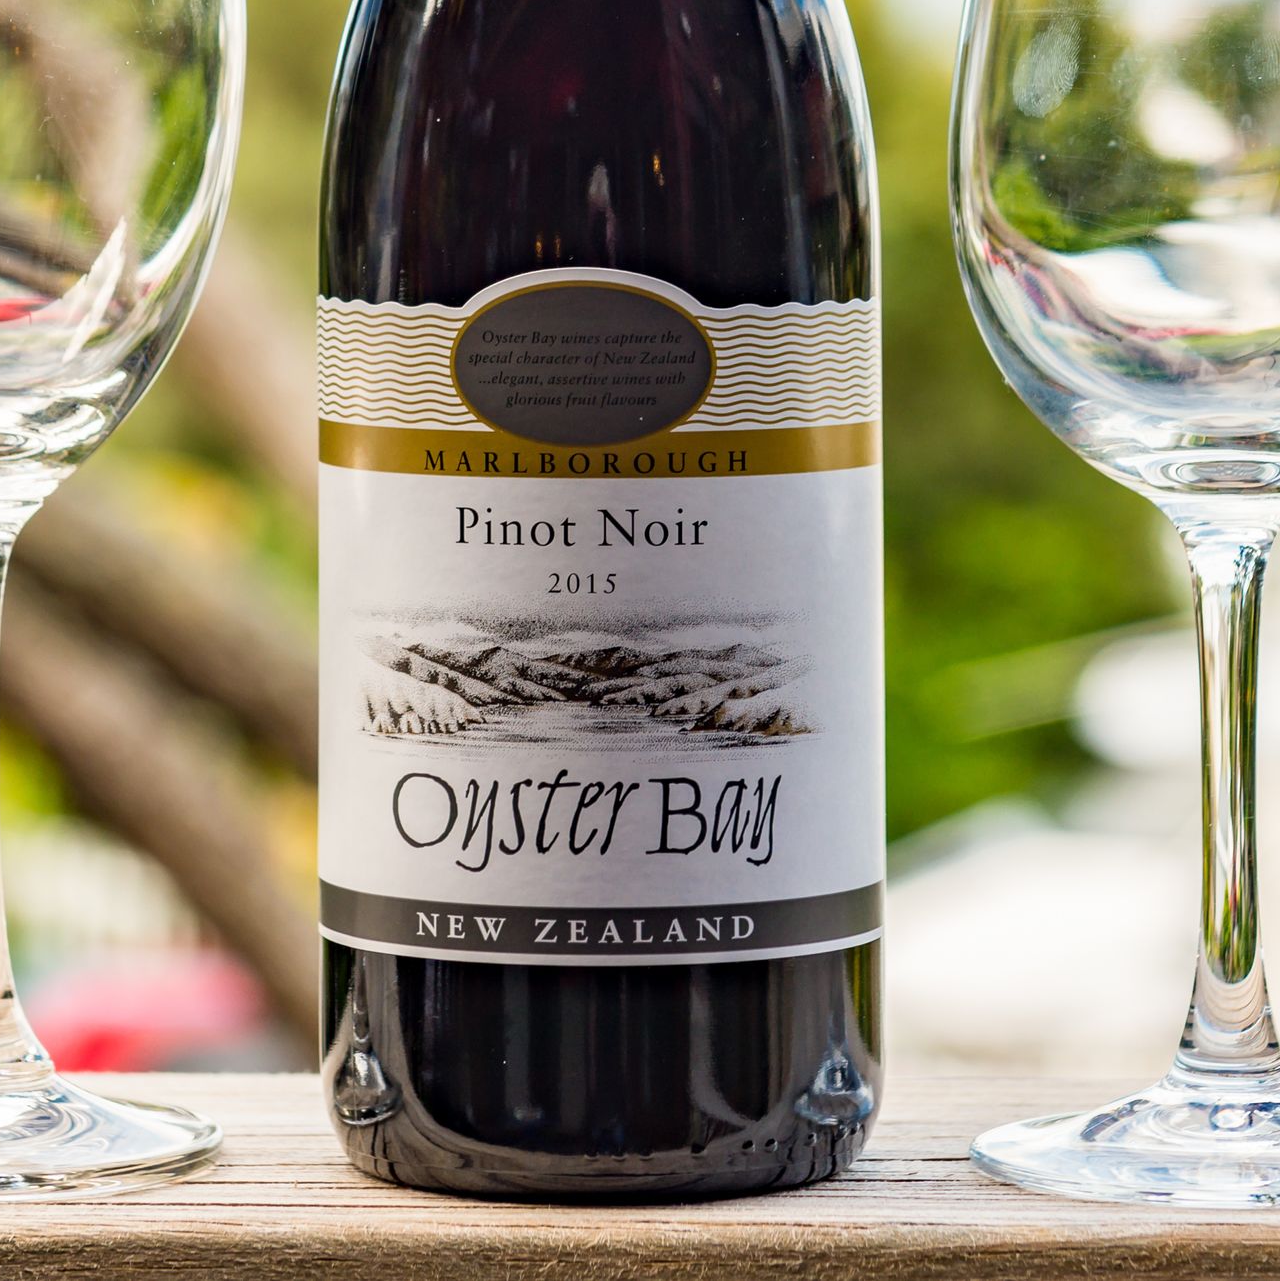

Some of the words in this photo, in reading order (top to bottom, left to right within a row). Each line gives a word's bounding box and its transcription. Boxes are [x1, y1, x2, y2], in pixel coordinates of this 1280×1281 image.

[482, 330, 527, 346] Oyster
[531, 331, 557, 347] Bay
[561, 332, 600, 344] wines
[604, 333, 656, 347] capture
[661, 330, 682, 344] the
[468, 351, 512, 367] special
[516, 351, 581, 365] character
[584, 351, 601, 367] of
[602, 352, 636, 365] New
[639, 350, 695, 365] Zealand
[547, 373, 608, 386] assertive
[612, 374, 651, 386] wines
[655, 371, 686, 386] with
[505, 392, 562, 408] glorious
[566, 392, 596, 408] fruit
[599, 392, 657, 408] flavours
[423, 450, 750, 475] MARLBOROUGH
[455, 506, 577, 548] Pinot
[597, 507, 708, 547] Noir
[547, 573, 618, 594] 2015
[392, 769, 639, 871] Oyster
[645, 774, 782, 867] Bay
[416, 912, 507, 941] NEW
[534, 914, 756, 944] ZEALAND
